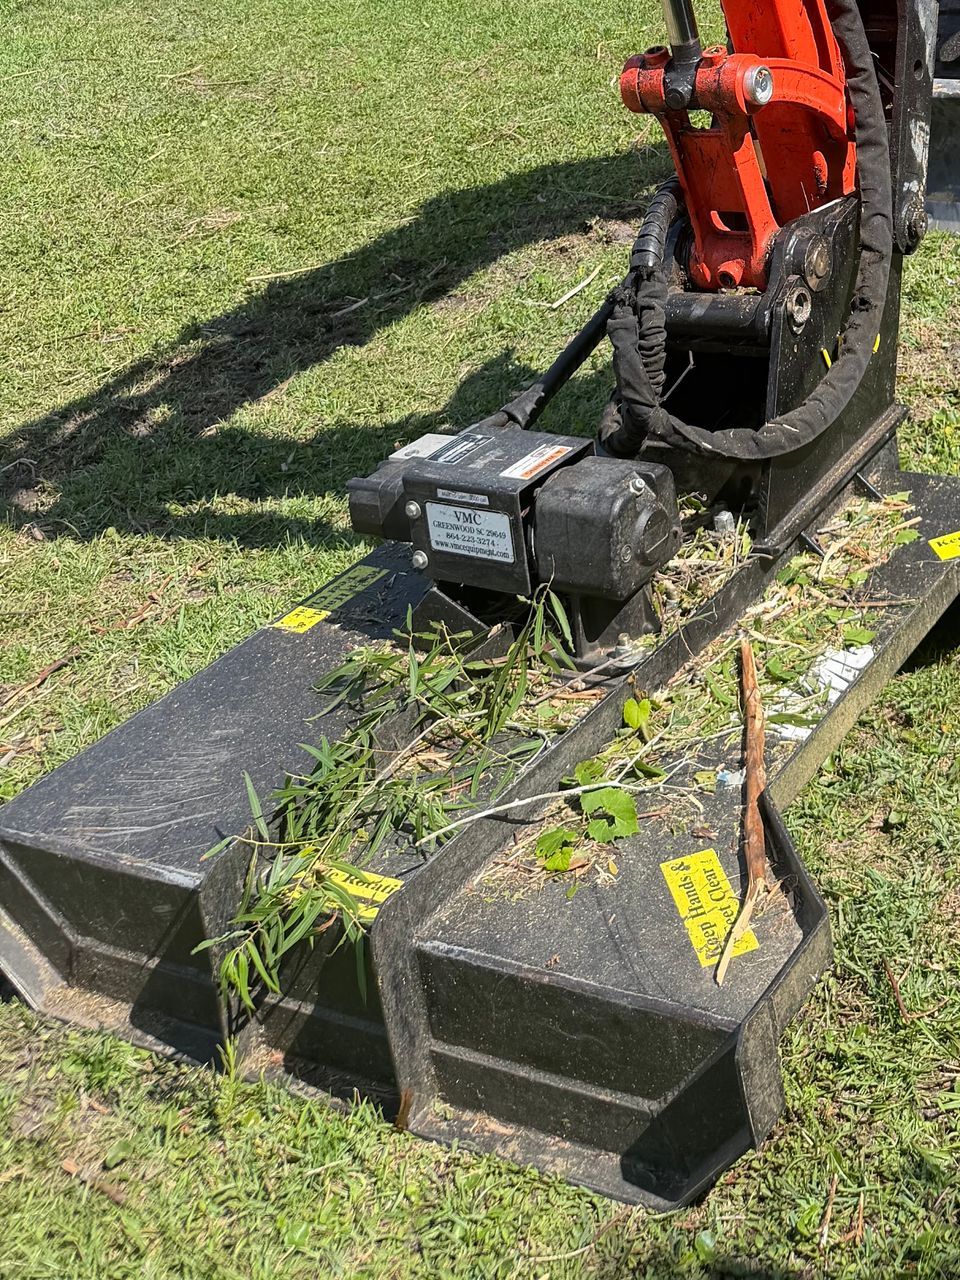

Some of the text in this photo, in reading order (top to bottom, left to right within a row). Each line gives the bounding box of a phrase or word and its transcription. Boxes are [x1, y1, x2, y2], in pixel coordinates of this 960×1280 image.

[453, 510, 482, 526] VMC
[432, 520, 475, 534] GREENWOOD
[476, 528, 485, 536] SC
[445, 532, 495, 547] 864-223-3274
[434, 540, 510, 559] www.vmcequipment.com
[702, 867, 735, 932] eet Clear
[670, 861, 723, 960] Keep Hands &
